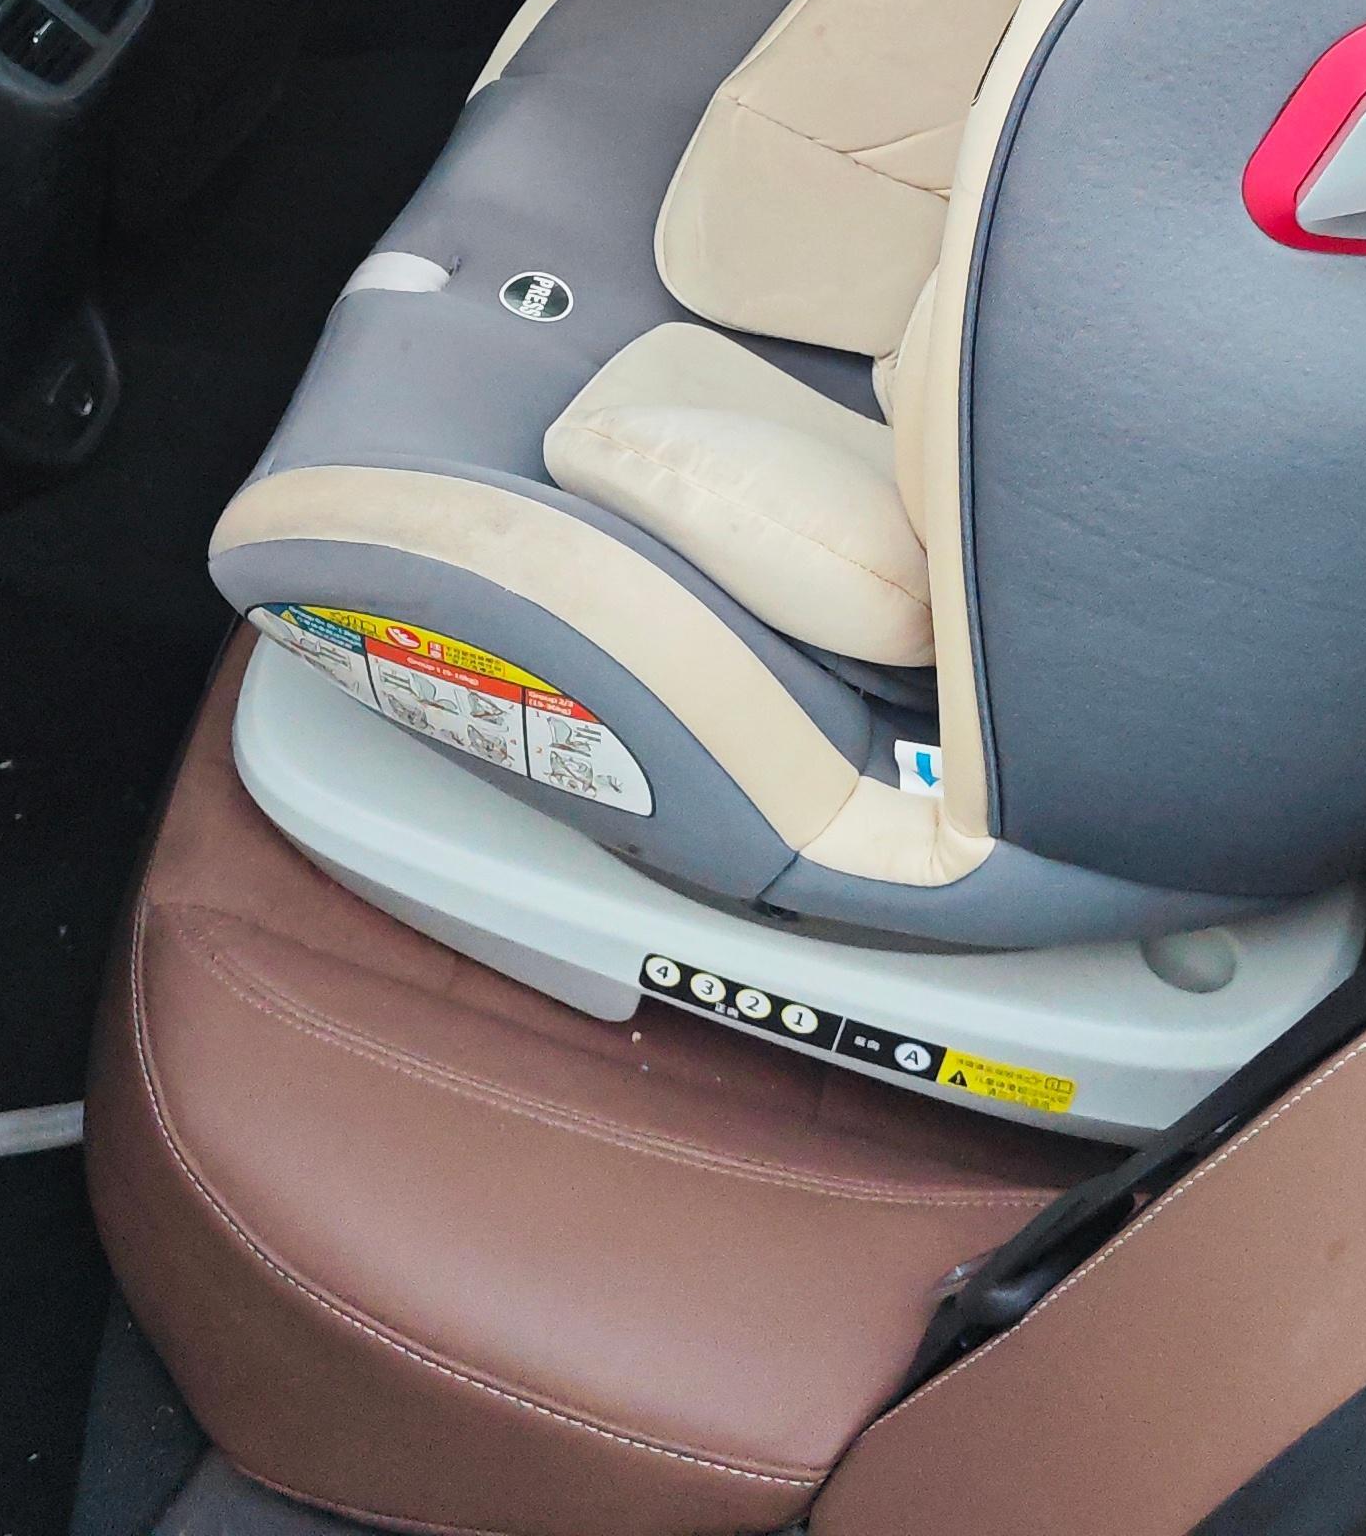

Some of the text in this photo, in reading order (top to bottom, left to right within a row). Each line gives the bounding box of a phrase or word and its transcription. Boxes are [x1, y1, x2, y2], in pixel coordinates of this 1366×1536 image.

[519, 276, 555, 317] PRESS
[656, 965, 803, 1027] 4 3 2 1
[904, 1050, 919, 1065] A
